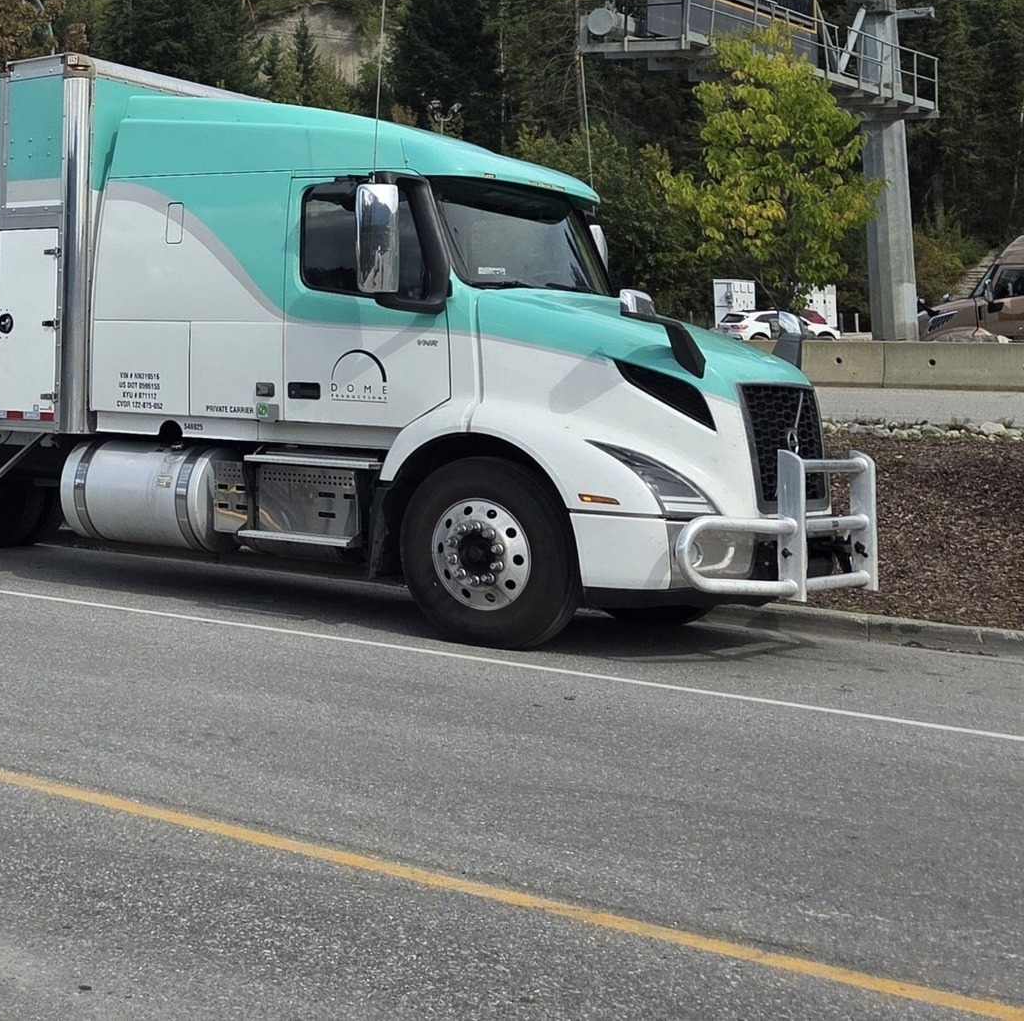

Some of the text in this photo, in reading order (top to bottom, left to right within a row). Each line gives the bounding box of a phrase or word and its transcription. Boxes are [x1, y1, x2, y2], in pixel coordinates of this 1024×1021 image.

[417, 339, 439, 347] VNR
[119, 371, 129, 379] VIN
[127, 381, 137, 389] DOT
[330, 383, 388, 395] DOME
[330, 393, 388, 401] PRODUCTIONS
[205, 405, 254, 414] PRIVATE CARRIER
